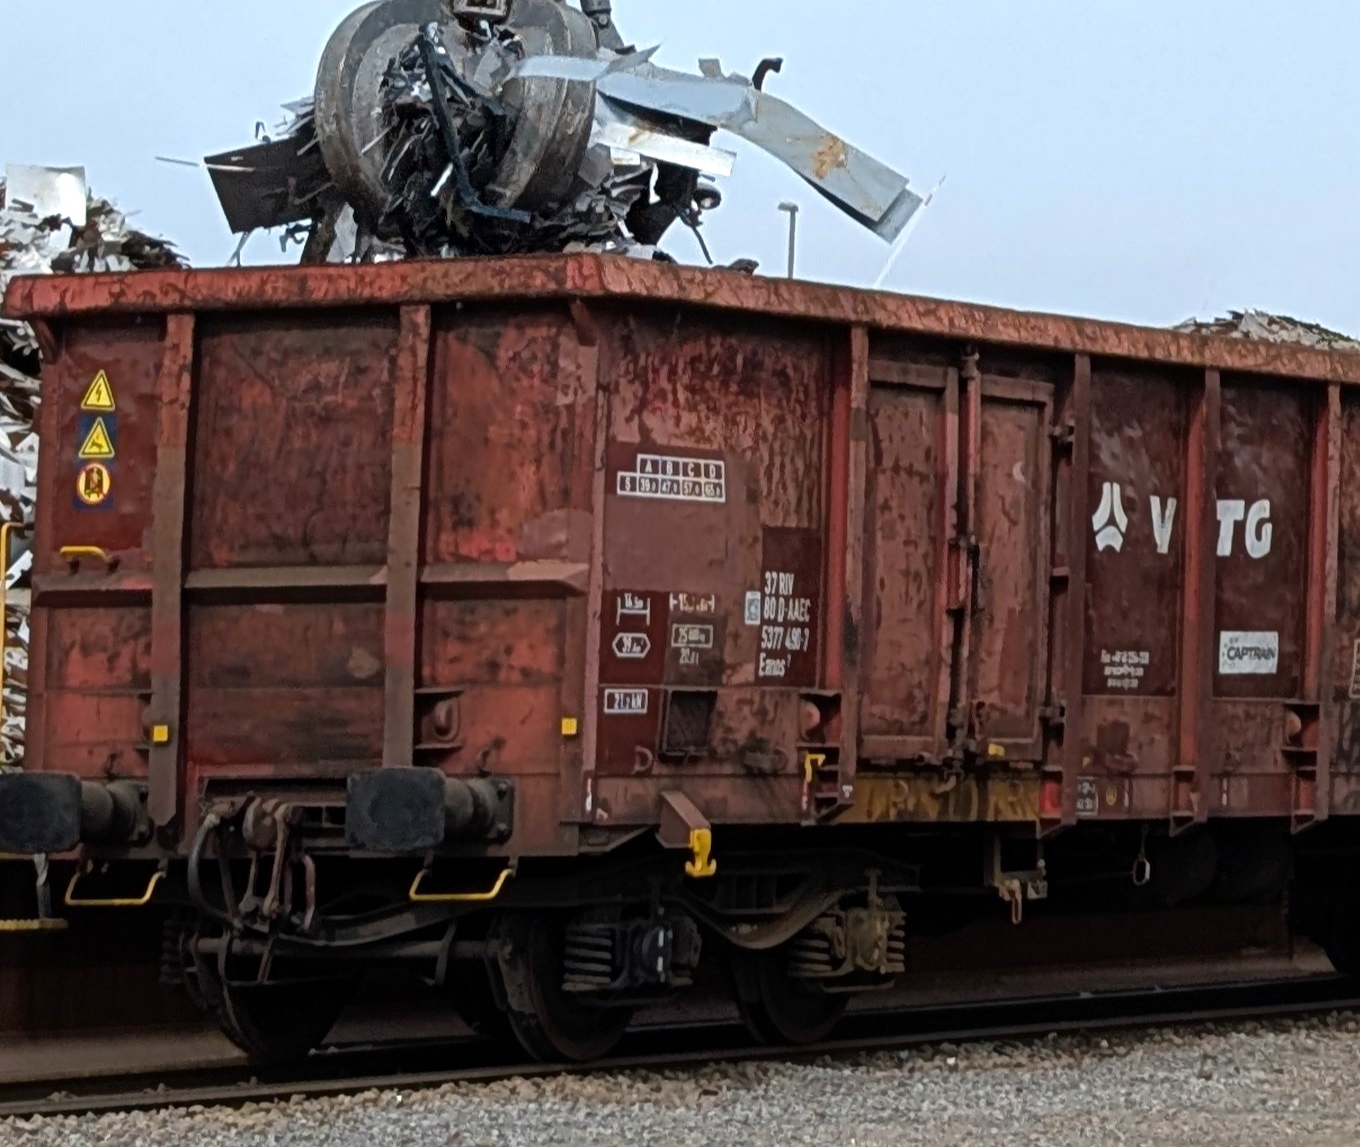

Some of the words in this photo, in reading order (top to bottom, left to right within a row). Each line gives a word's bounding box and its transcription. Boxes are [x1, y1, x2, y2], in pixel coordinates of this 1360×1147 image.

[644, 459, 653, 473] A
[666, 460, 673, 476] B
[687, 462, 695, 477] C
[709, 464, 716, 479] D
[624, 477, 631, 492] S
[764, 571, 778, 595] 37
[778, 572, 795, 595] RIV
[763, 596, 777, 620] 80
[761, 625, 784, 650] 5377
